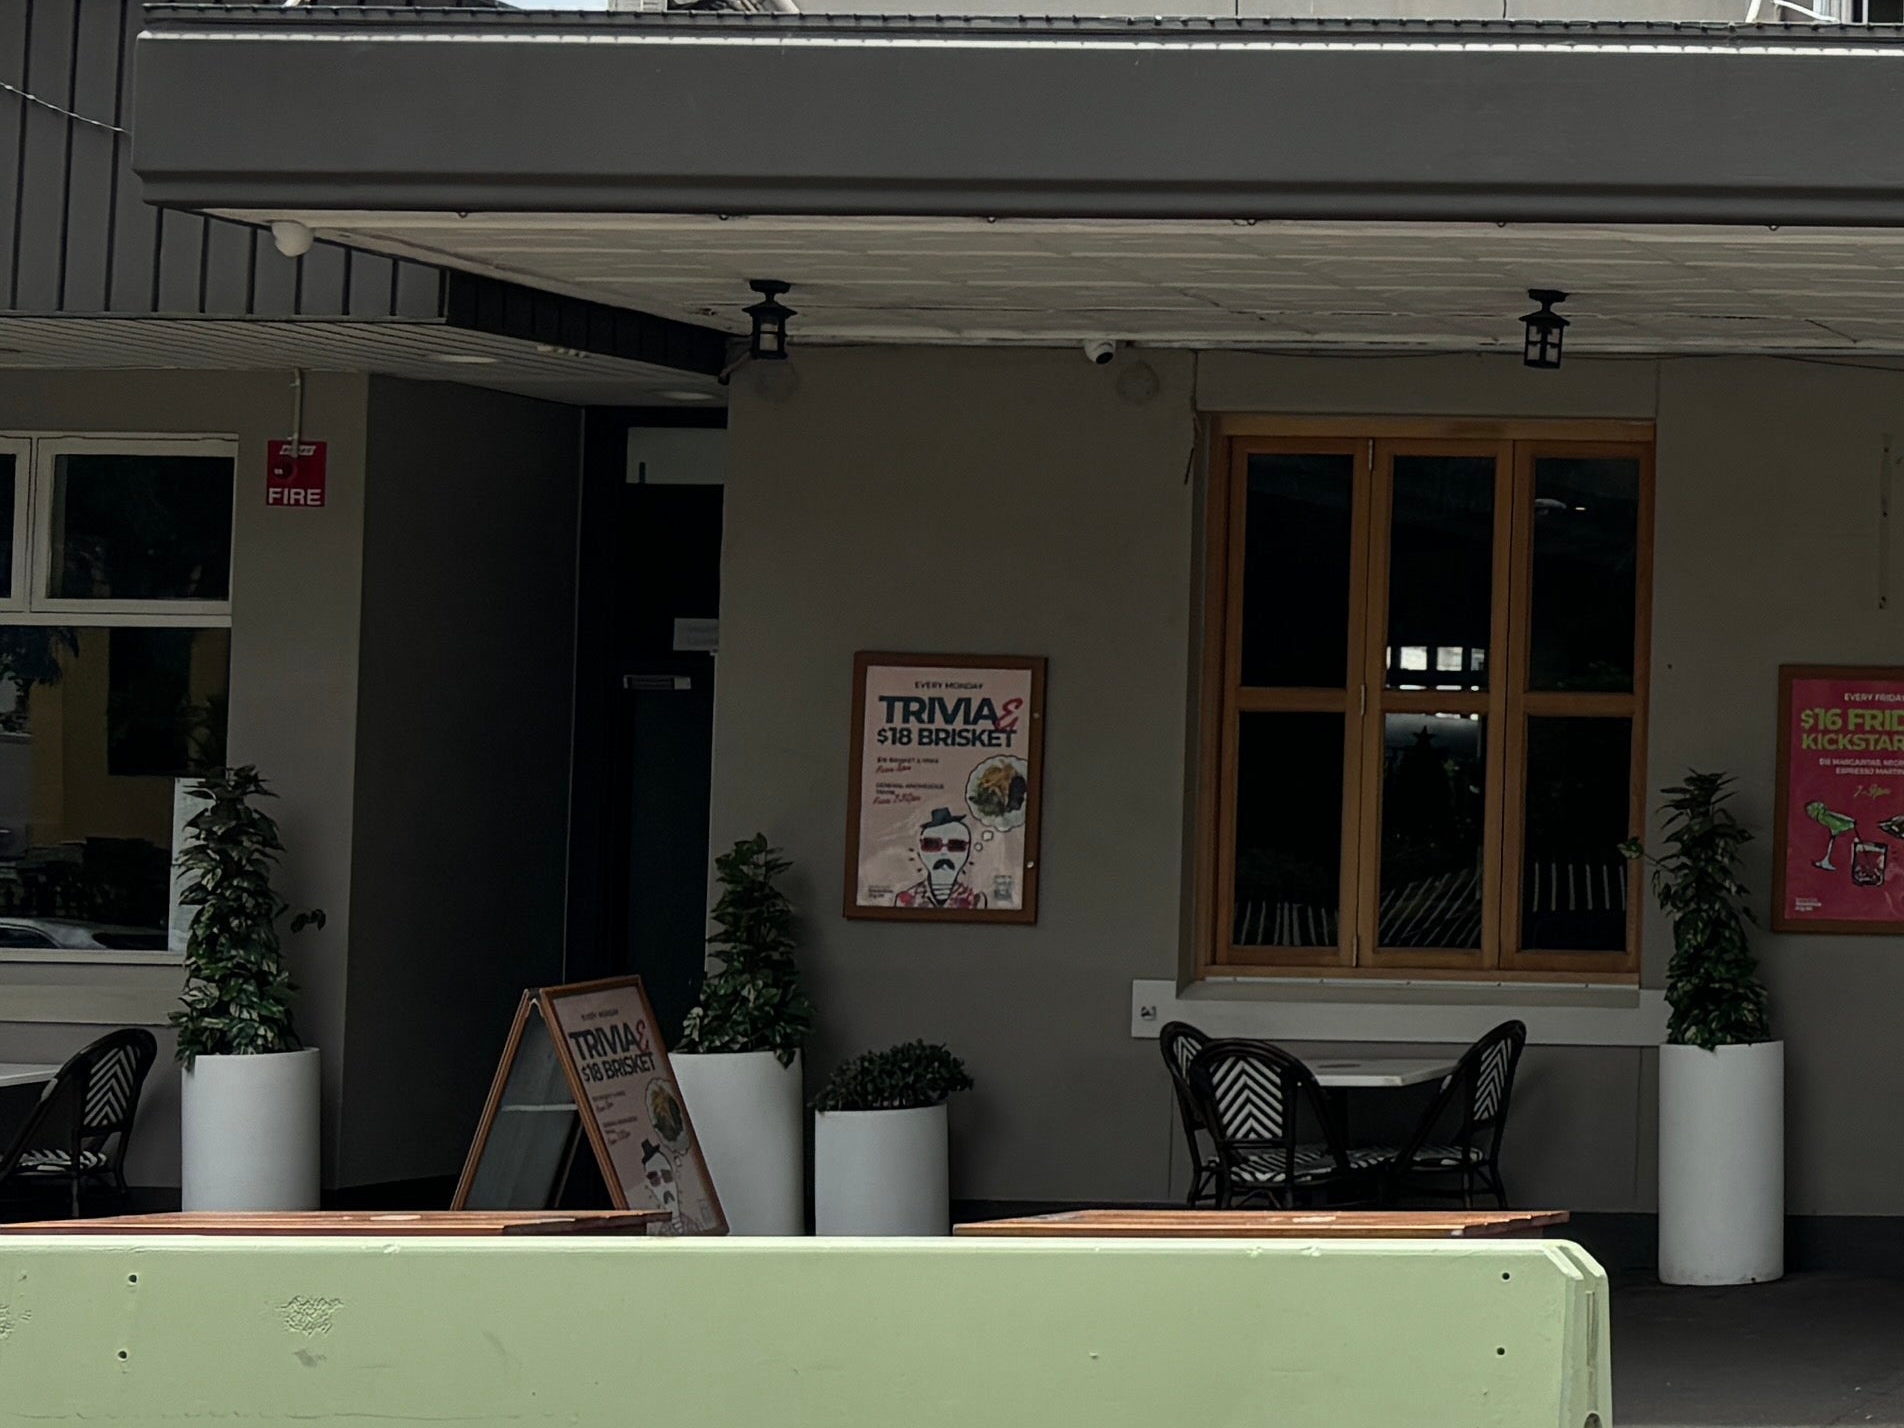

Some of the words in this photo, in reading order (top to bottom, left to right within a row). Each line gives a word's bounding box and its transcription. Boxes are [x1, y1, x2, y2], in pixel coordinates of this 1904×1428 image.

[268, 488, 321, 505] FIRE
[915, 681, 942, 689] EVERY
[1844, 693, 1873, 701] EVERY
[878, 695, 998, 726] TRIVIA
[1800, 708, 1842, 731] $16
[877, 727, 912, 745] $18
[918, 728, 1018, 748] BRISKET
[568, 1022, 642, 1061] TRIVIA
[581, 1062, 604, 1083] $18
[602, 1052, 655, 1079] BRISKET
